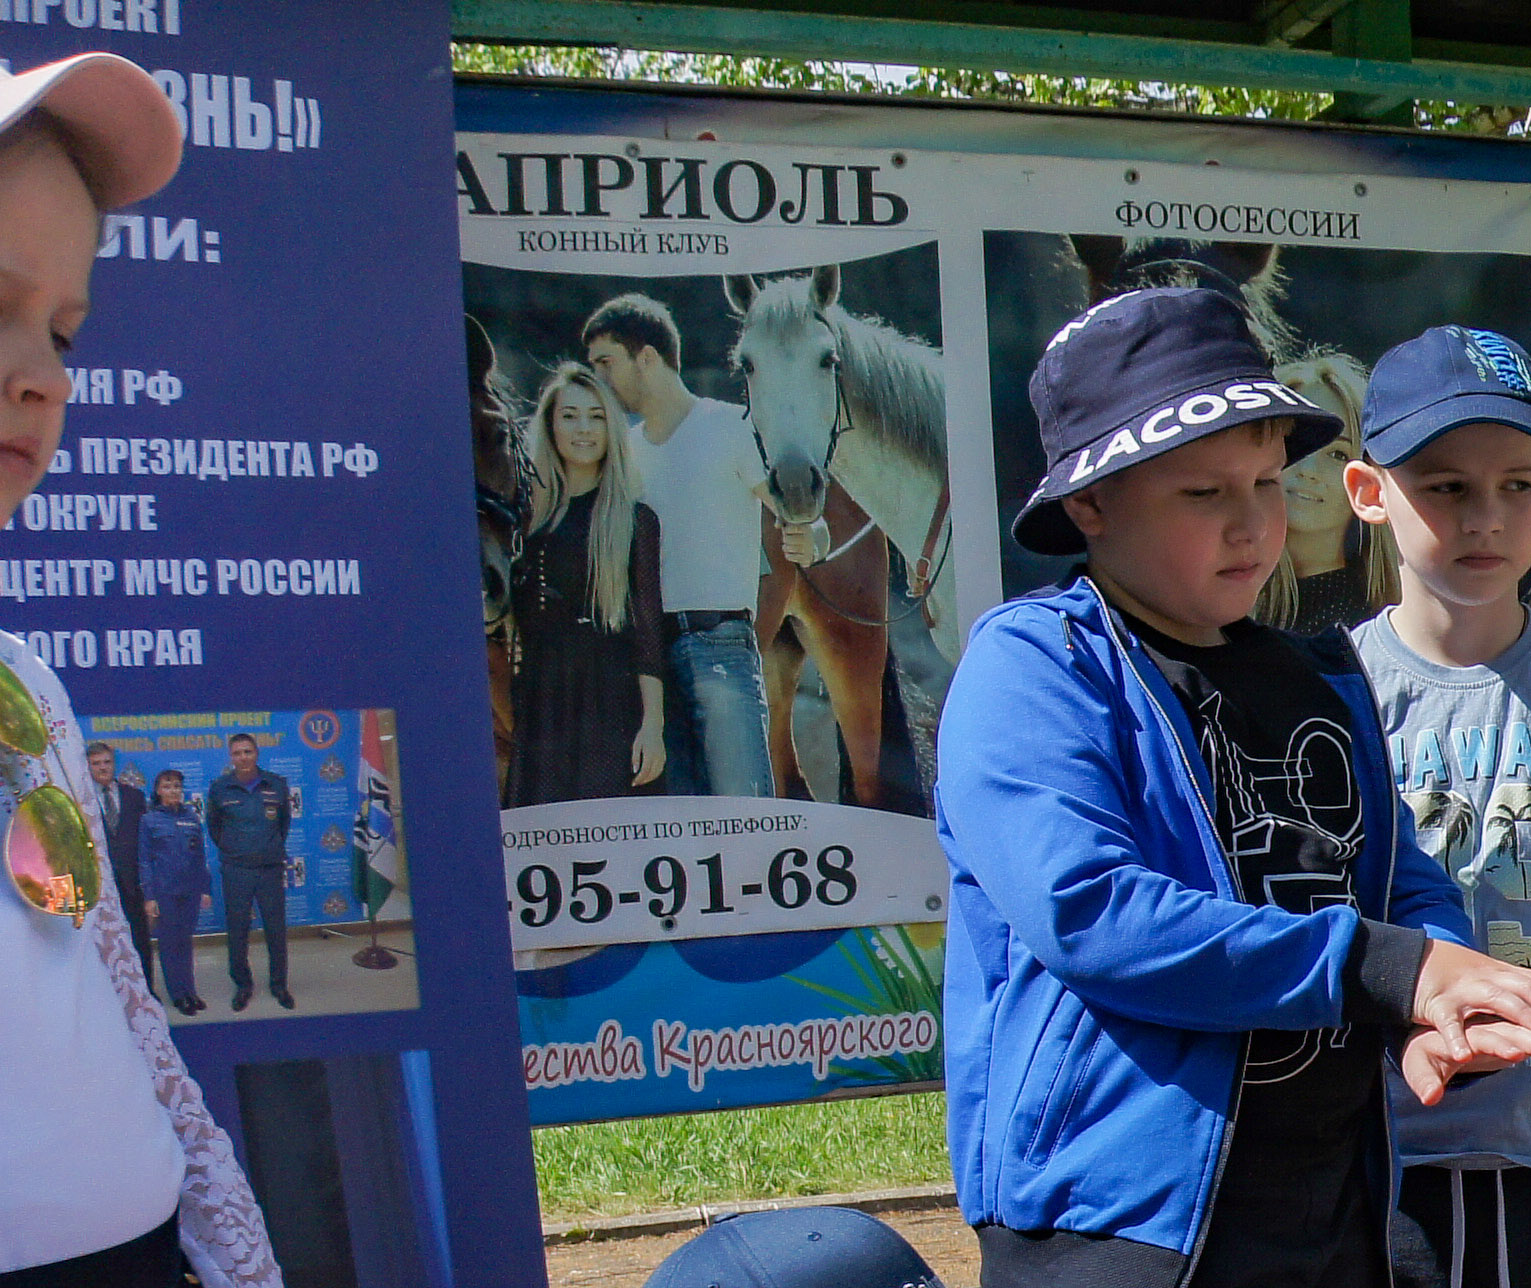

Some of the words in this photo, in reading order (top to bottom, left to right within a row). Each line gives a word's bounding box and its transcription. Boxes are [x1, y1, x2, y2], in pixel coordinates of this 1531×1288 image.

[1115, 200, 1361, 240] ФОТОСЕССИИ
[518, 227, 649, 254] КОННЫЙ
[657, 234, 729, 256] КЛУБ
[124, 368, 183, 406] РФ
[81, 437, 316, 481] ПРЕЗИДЕНТА
[322, 442, 379, 477] РФ
[23, 494, 158, 531] ОКРУГЕ
[124, 559, 208, 597] МЧС
[217, 558, 361, 596] РОССИИ
[106, 628, 203, 668] КРАЯ
[654, 822, 684, 839] ПО
[689, 814, 808, 837] ТЕЛЕФОНУ:
[509, 844, 859, 928] 95-91-68
[657, 1012, 934, 1088] Красноярского
